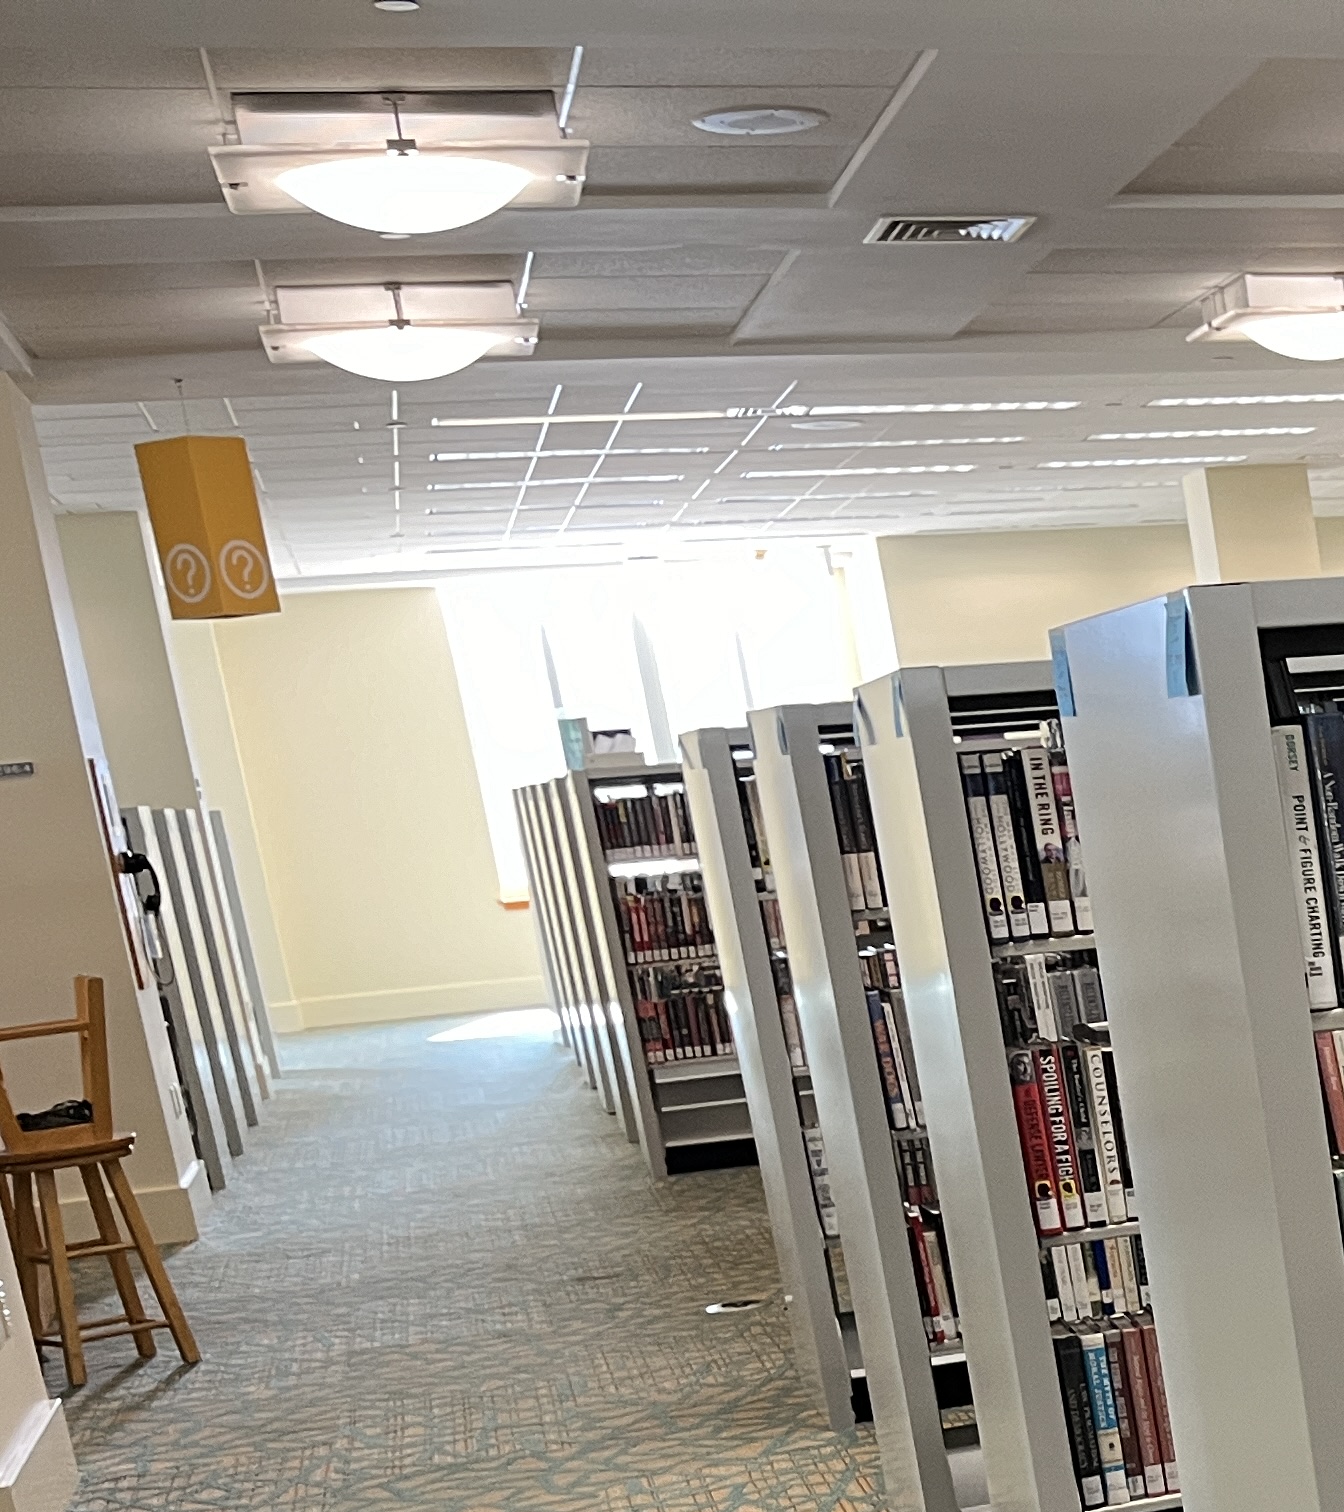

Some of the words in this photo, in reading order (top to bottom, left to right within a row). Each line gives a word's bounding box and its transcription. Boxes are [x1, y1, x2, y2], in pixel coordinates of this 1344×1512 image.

[1029, 755, 1044, 772] IN
[1284, 733, 1299, 772] DORSEY
[1031, 774, 1049, 799] THE
[1036, 801, 1054, 836] RING
[1291, 794, 1308, 832] POINT
[973, 816, 994, 896] HOLLYWOOD
[995, 815, 1015, 893] HOLLYWOOD
[1298, 833, 1309, 846] &
[1298, 846, 1316, 894] FIGURE
[1304, 896, 1325, 958] CHARTING
[1035, 1054, 1066, 1115] SPOILING
[1048, 1114, 1068, 1141] FOR
[1086, 1053, 1121, 1173] COUNSELORS
[1054, 1142, 1070, 1153] A
